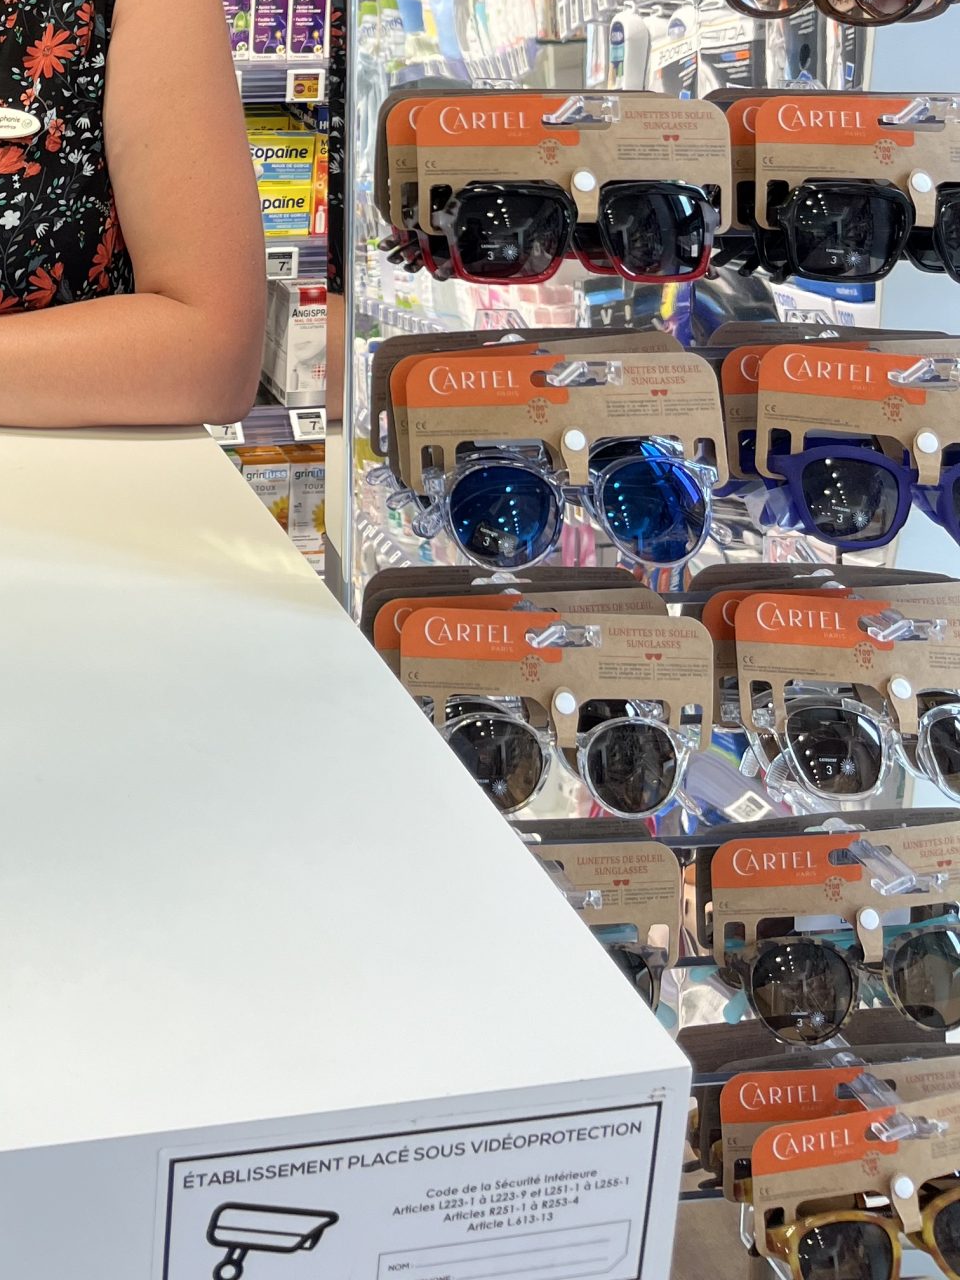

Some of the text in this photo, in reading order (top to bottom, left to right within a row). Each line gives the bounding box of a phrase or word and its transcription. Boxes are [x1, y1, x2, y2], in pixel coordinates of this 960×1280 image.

[439, 106, 531, 135] CARTEL
[643, 121, 697, 131] SUNGLASSES
[778, 103, 866, 132] CARTEL
[250, 142, 308, 162] sopaïne
[783, 353, 877, 385] CARTEL
[428, 366, 520, 395] CARTEL
[631, 376, 686, 385] SUNGLASSES
[246, 470, 287, 481] grinTuss
[608, 628, 699, 639] LUNETTES DE SOLEIL
[626, 639, 681, 649] SUNGLASSES
[594, 865, 649, 876] SUNGLASSES
[183, 1121, 642, 1189] ÉTABLISSEMENT PLACÉ SOUS VIDÉOPROTECTION
[426, 1169, 598, 1199] Code de la Sécurité Intérieure
[392, 1176, 630, 1216] Articles L223-1 à L223-9 et L251-1 à L255-1
[443, 1195, 579, 1223] Articles R251-1 à R253-4
[467, 1212, 554, 1233] Article L.613-13
[388, 1263, 410, 1271] NOM
